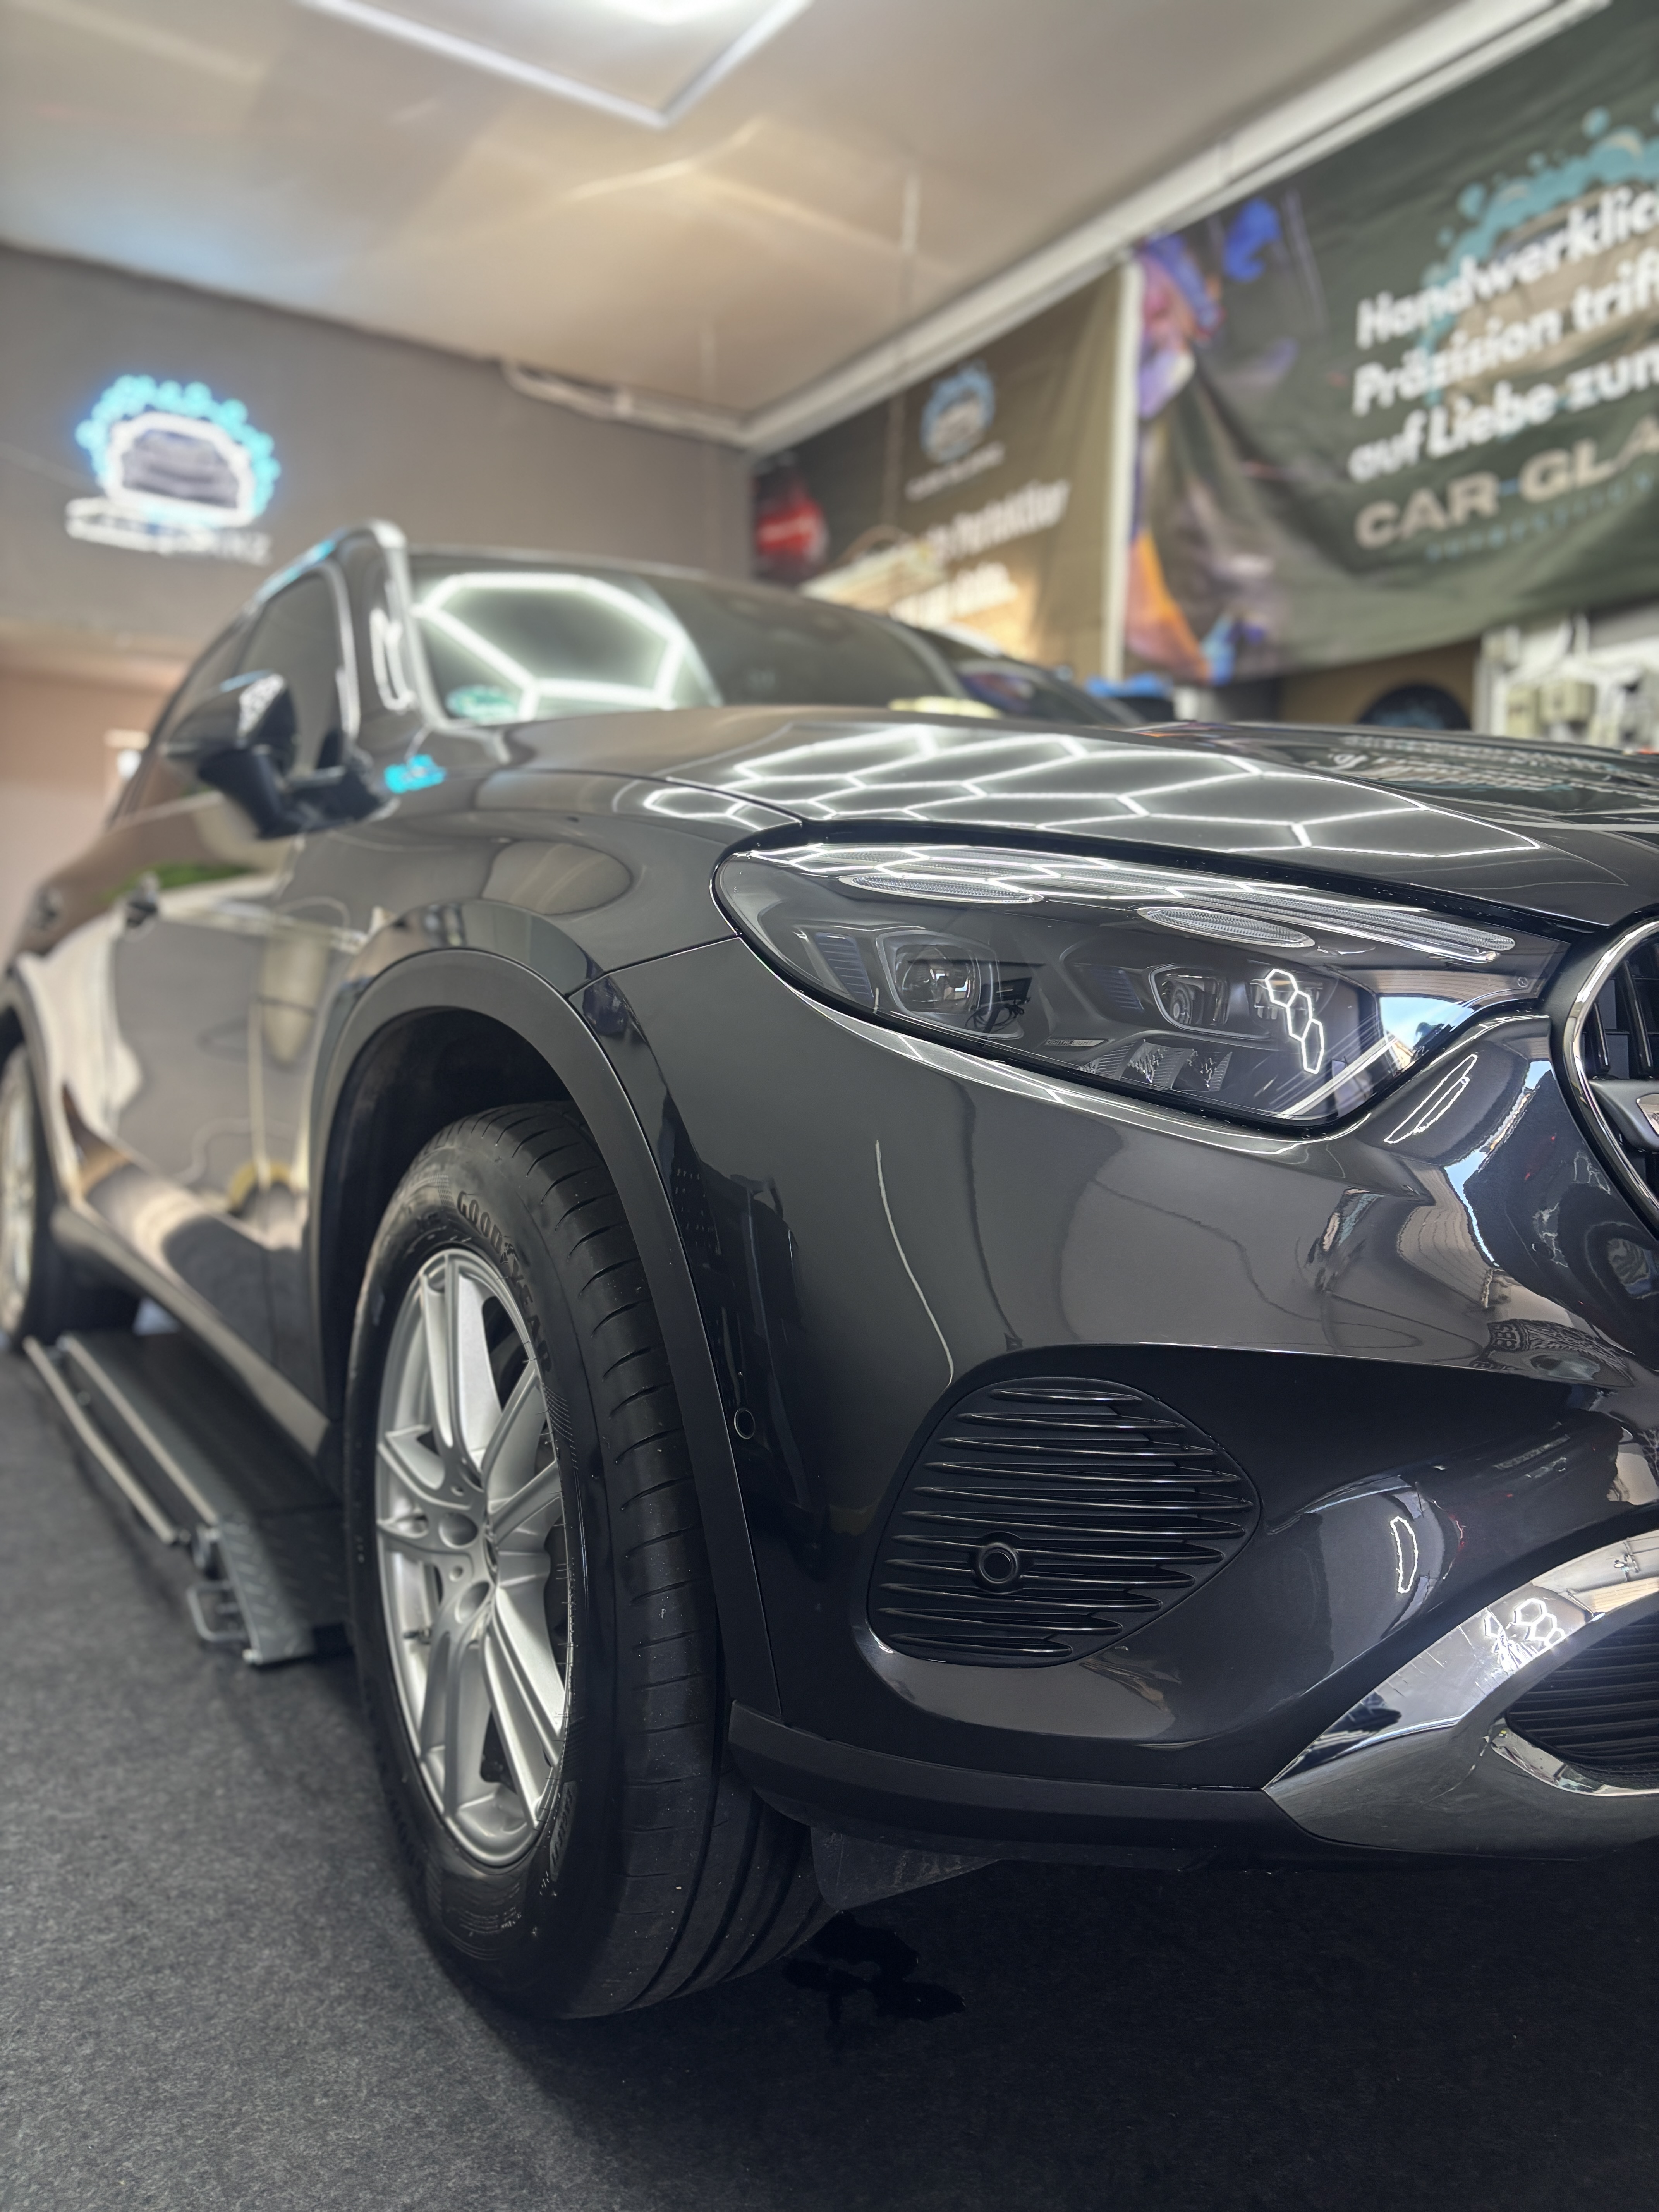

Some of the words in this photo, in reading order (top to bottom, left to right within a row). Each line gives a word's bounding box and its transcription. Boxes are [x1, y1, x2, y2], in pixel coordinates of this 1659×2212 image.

[1352, 310, 1563, 417] Präzision
[1572, 247, 1659, 331] trif
[1348, 409, 1427, 483] auf
[1426, 380, 1557, 459] Liebe
